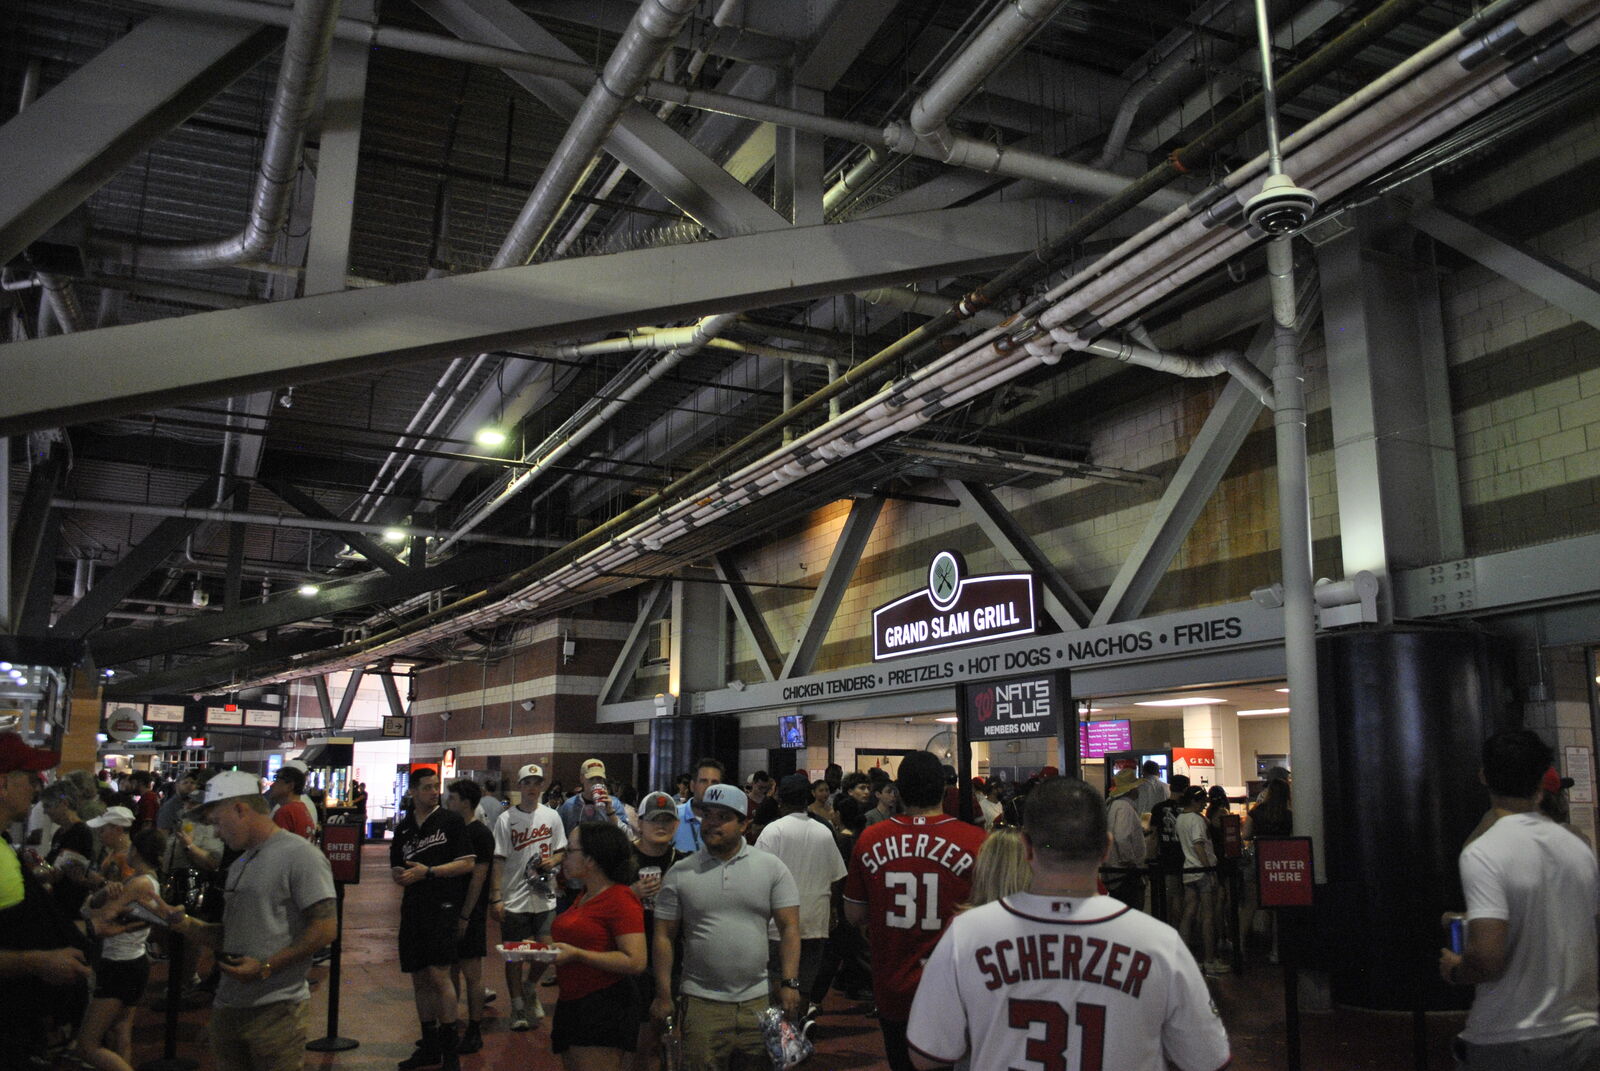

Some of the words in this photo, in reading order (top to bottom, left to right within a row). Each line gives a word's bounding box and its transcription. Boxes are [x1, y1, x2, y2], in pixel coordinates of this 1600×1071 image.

[885, 620, 928, 648] GRAND
[931, 611, 970, 639] SLAM
[973, 602, 1020, 630] GRILL
[783, 682, 824, 700] CHICKEN
[826, 674, 875, 694] TENDERS
[888, 662, 953, 686] PRETZELS
[968, 655, 1000, 675] HOT
[1004, 647, 1050, 670] DOGS
[1068, 631, 1152, 661] NACHOS
[1174, 617, 1242, 646] FRIES
[996, 680, 1049, 703] NATS
[996, 699, 1050, 721] PLUS
[984, 723, 1018, 735] MEMBERS
[1020, 721, 1040, 733] ONLY
[710, 789, 722, 801] W
[327, 842, 355, 851] ENTER
[329, 852, 352, 861] HERE
[861, 834, 975, 877] SCHERZER
[1264, 860, 1305, 870] ENTER
[1269, 871, 1302, 882] HERE
[884, 871, 943, 931] 31
[975, 934, 1152, 999] SCHERZER
[1008, 998, 1106, 1071] 31
